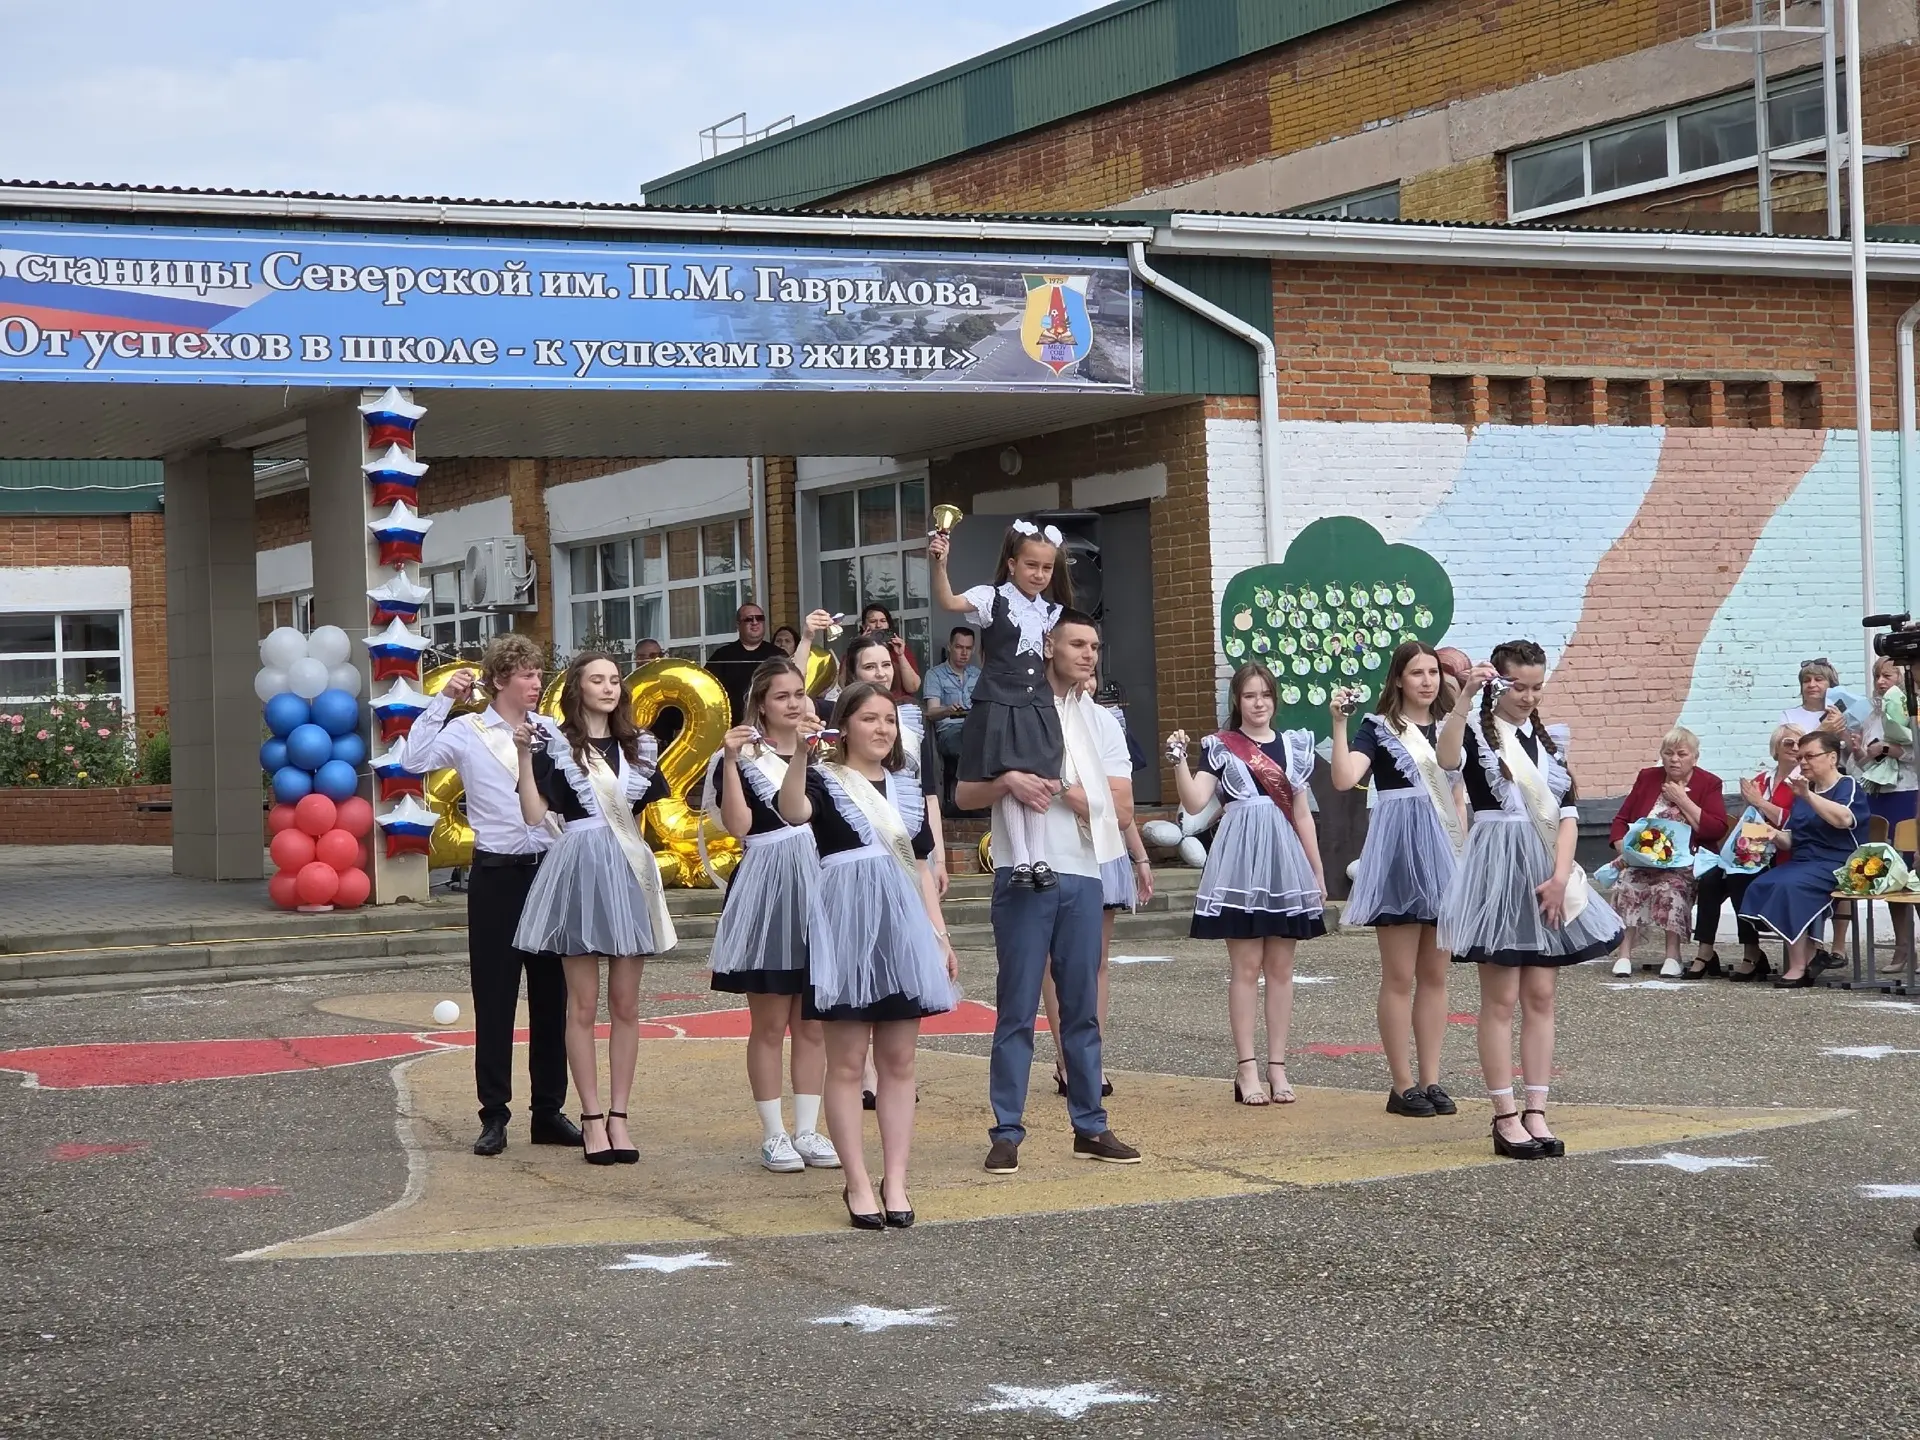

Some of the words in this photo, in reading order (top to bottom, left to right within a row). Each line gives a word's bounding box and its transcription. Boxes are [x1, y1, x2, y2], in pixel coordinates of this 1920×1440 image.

[17, 255, 251, 295] станицы
[261, 251, 532, 306] Северской
[540, 270, 619, 299] им.
[628, 263, 744, 303] П.М.
[753, 266, 980, 316] Гаврилова
[1049, 277, 1064, 285] 1975
[0, 315, 71, 358] От
[80, 330, 291, 369] успехов
[300, 335, 332, 362] в
[340, 336, 498, 364] школе
[534, 339, 566, 366] к
[572, 340, 759, 377] успехам
[767, 342, 794, 369] в
[800, 343, 979, 370] жизни»
